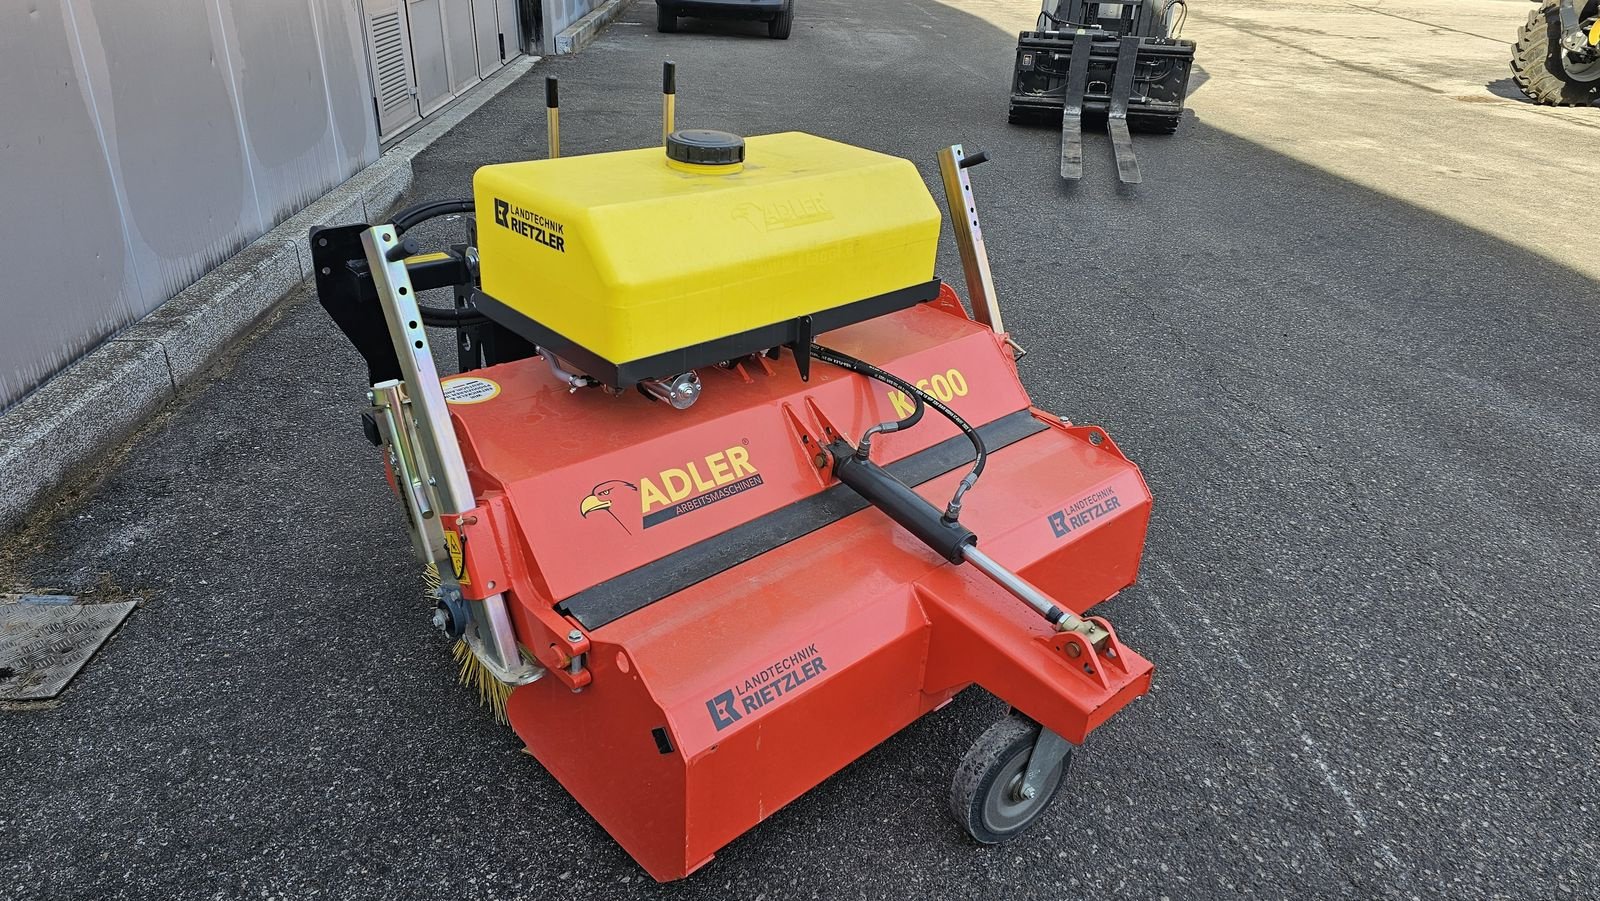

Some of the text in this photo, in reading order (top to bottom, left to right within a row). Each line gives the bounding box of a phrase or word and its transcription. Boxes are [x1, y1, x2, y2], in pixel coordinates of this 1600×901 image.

[511, 204, 564, 235] LANDTECHNIK
[511, 220, 565, 253] RIETZLER
[640, 445, 758, 514] ADLER
[676, 476, 762, 515] ARBEITSMASCHINEN
[1064, 485, 1115, 516] LANDTECHNIK
[1069, 495, 1121, 530] RIETZLER
[735, 642, 819, 697] LANDTECHNIK
[741, 656, 828, 715] RIETZLER
